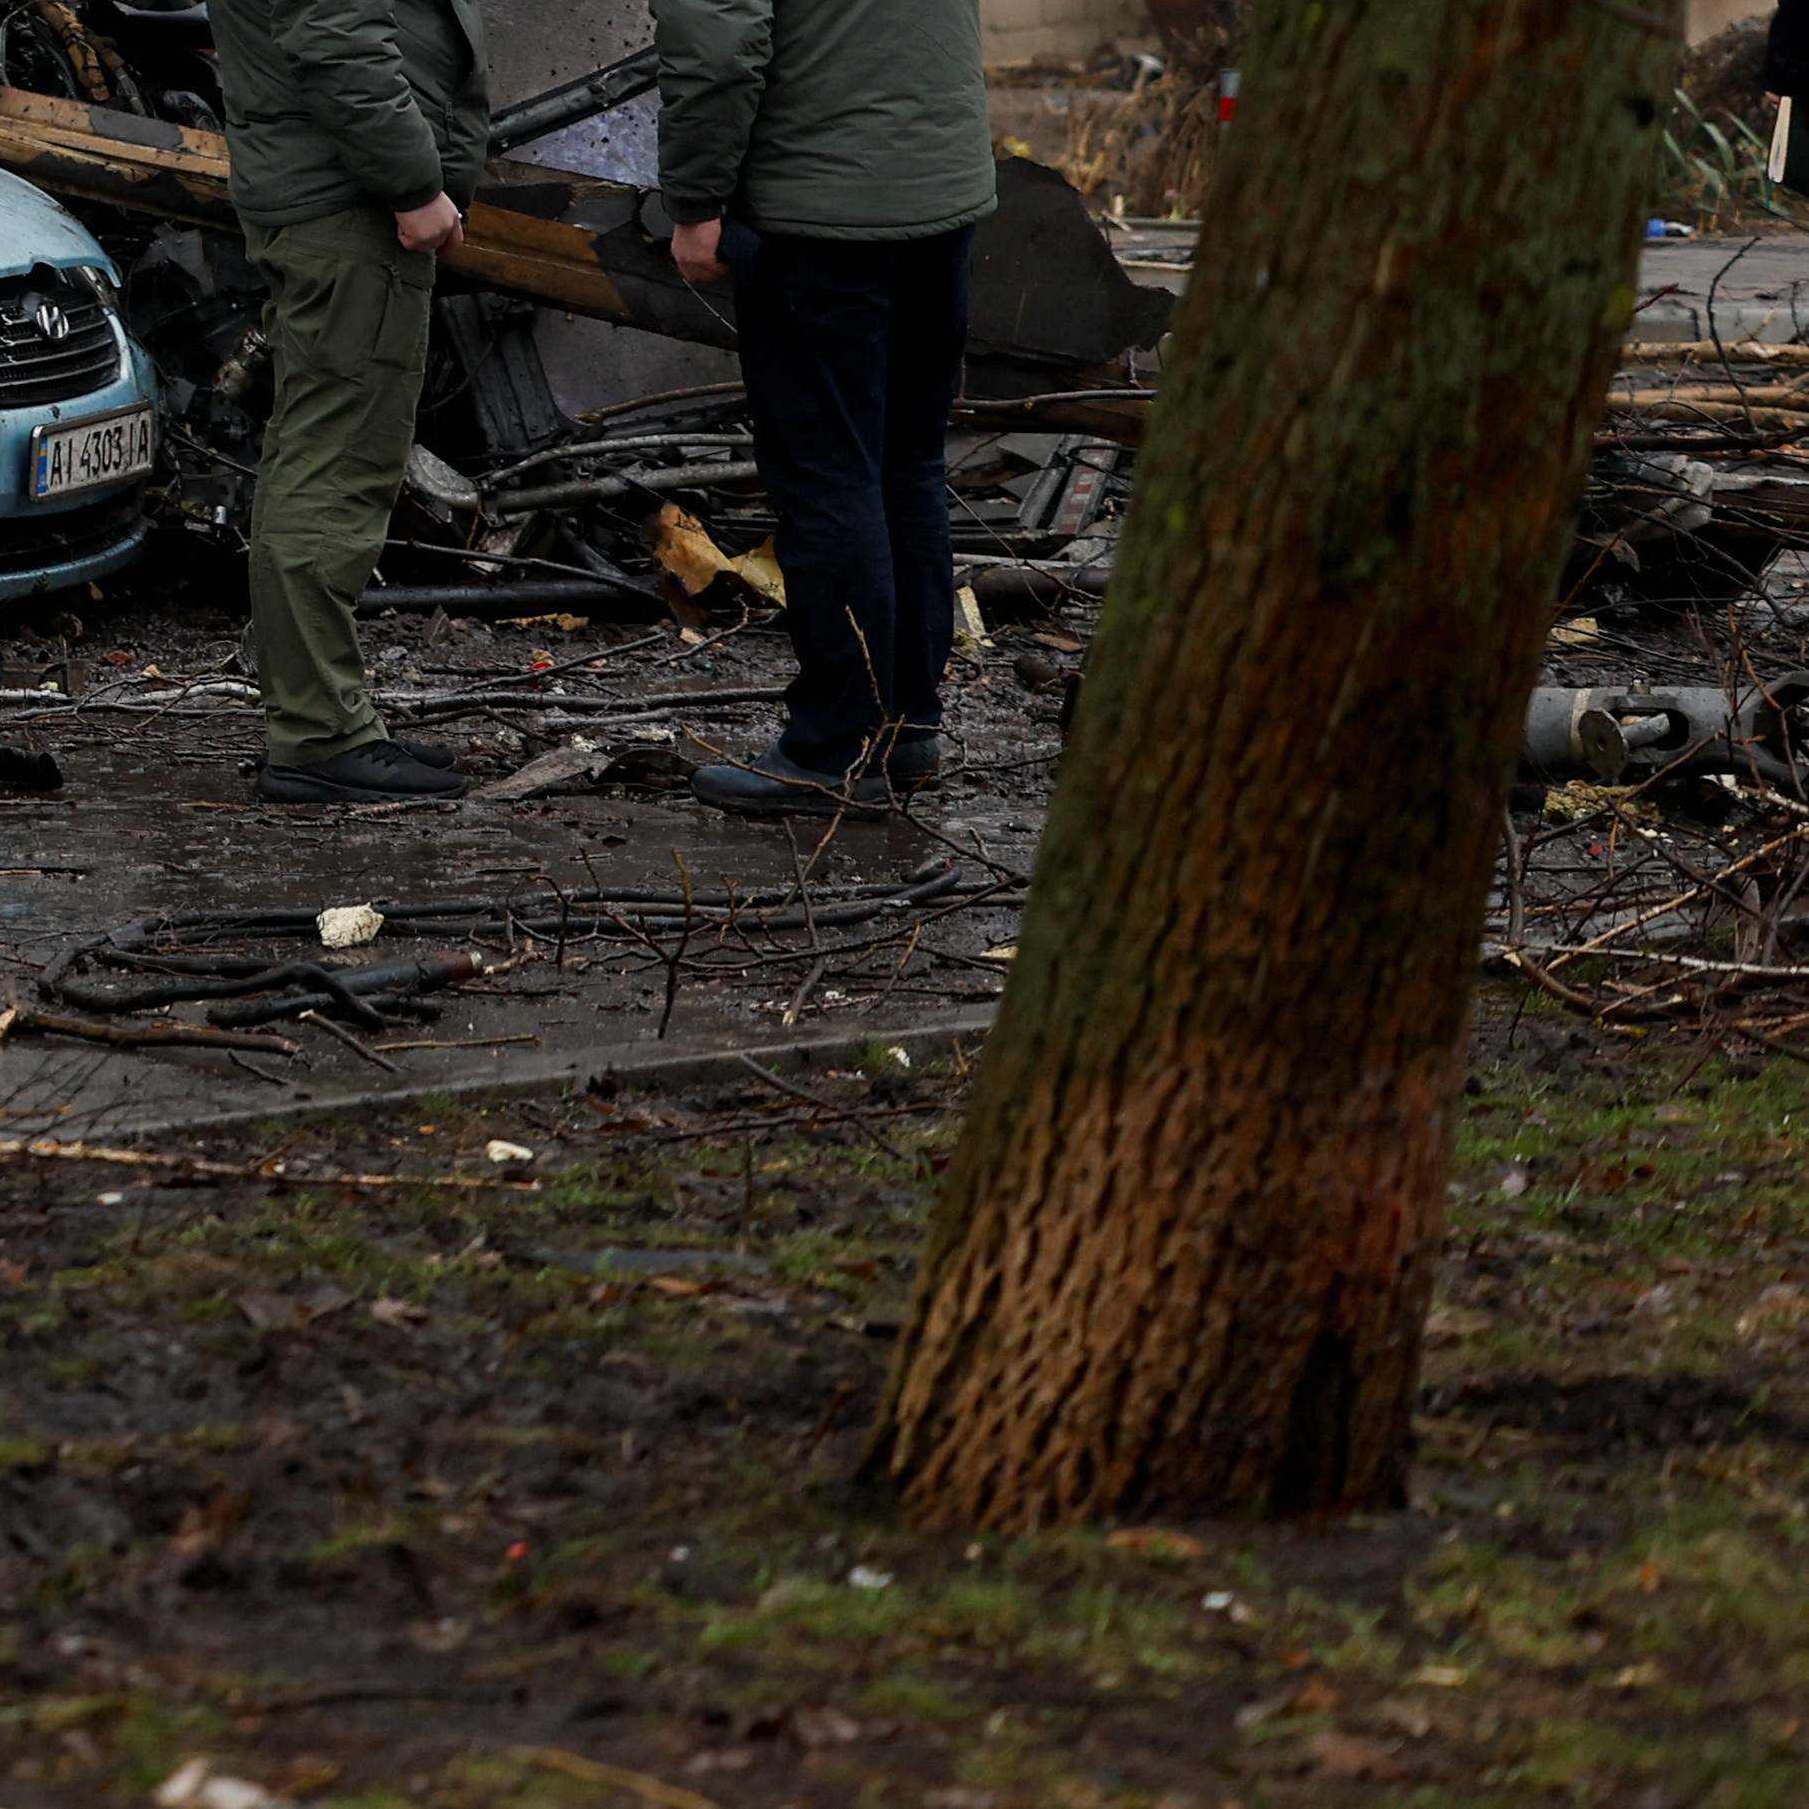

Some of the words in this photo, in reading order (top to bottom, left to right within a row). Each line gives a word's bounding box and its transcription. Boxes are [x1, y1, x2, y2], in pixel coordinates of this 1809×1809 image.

[50, 437, 73, 486] AI
[80, 425, 123, 478] 4303
[129, 419, 149, 466] IA
